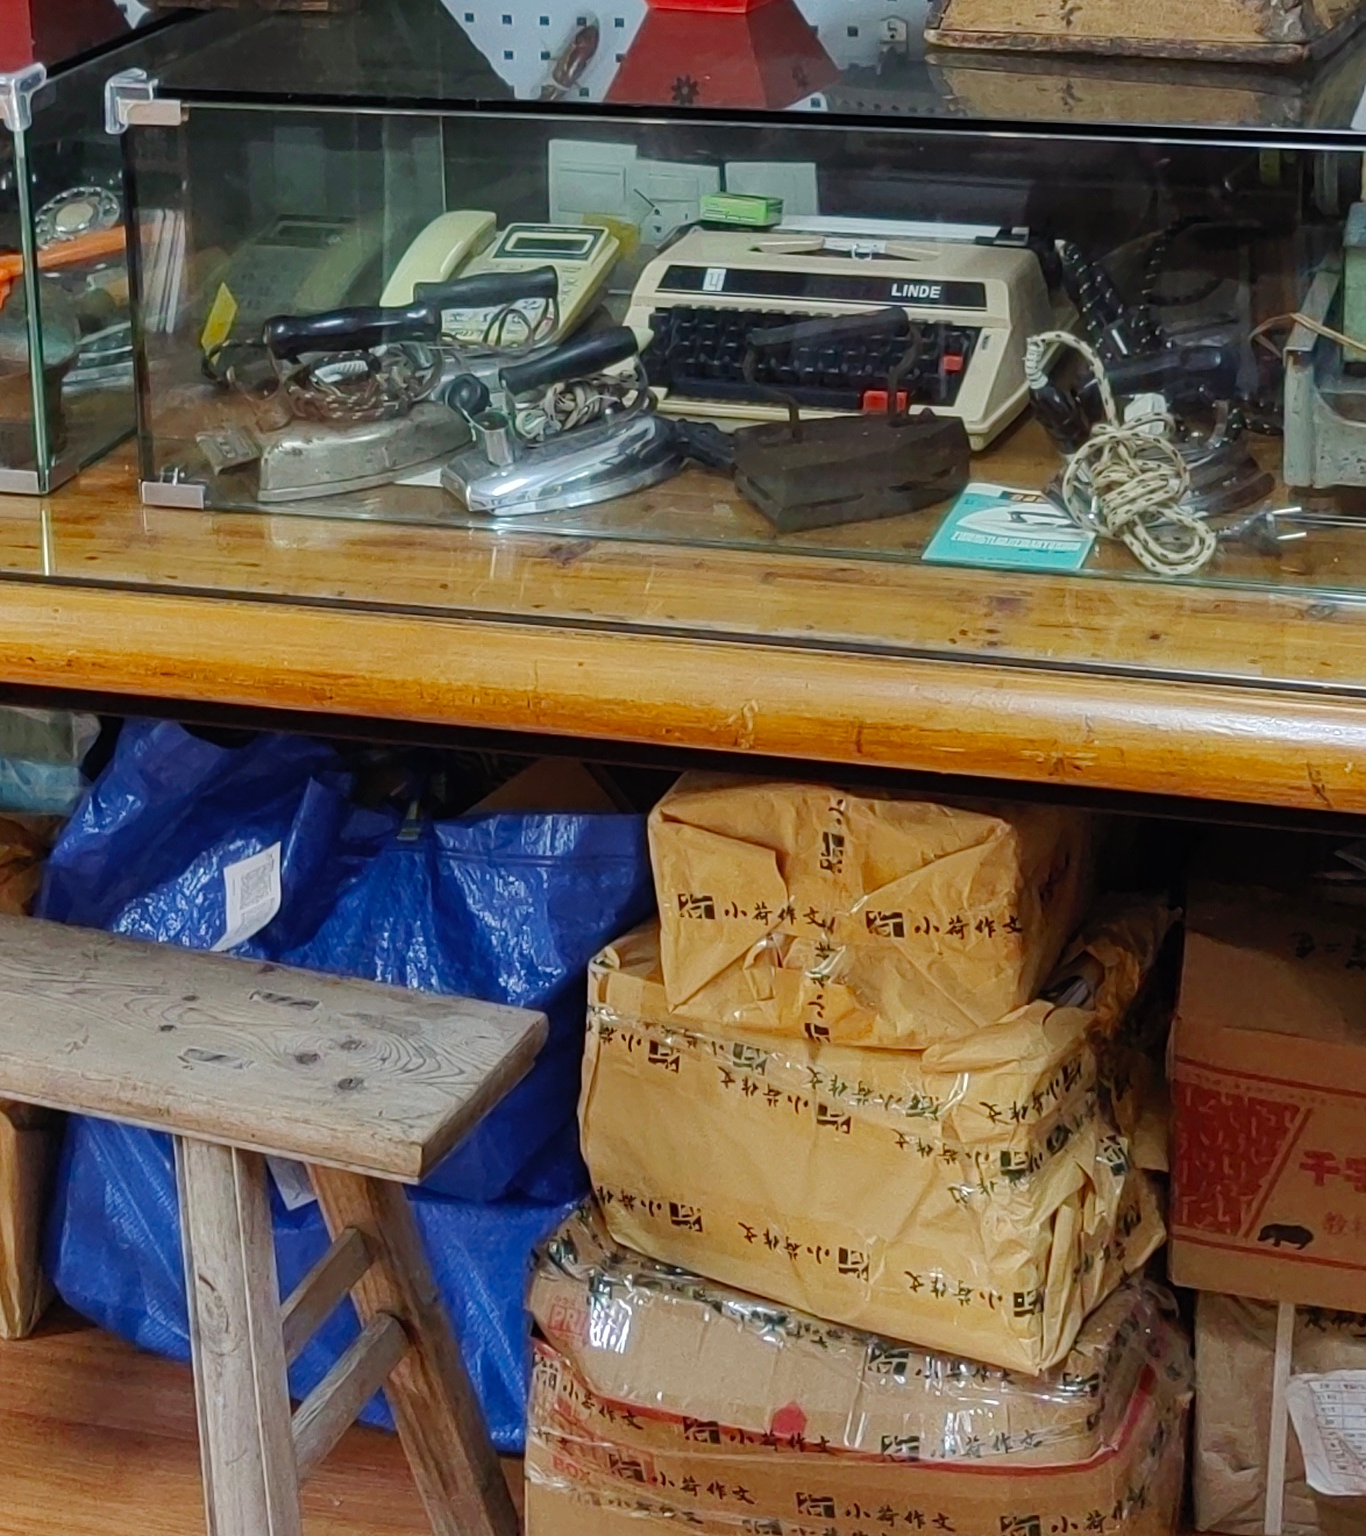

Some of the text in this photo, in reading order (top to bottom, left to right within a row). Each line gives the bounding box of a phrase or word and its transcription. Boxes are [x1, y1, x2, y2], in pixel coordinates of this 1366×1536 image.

[891, 282, 942, 299] LINDE
[724, 900, 824, 927] 小荷作文
[914, 915, 1024, 940] 小荷作文
[717, 1066, 809, 1114] 小荷作文
[737, 1221, 830, 1264] 小荷作文
[904, 1270, 1003, 1310] 小荷作文
[730, 1428, 831, 1454] 小荷作文
[651, 1470, 756, 1505] 小荷作文
[845, 1502, 956, 1533] 小荷作文
